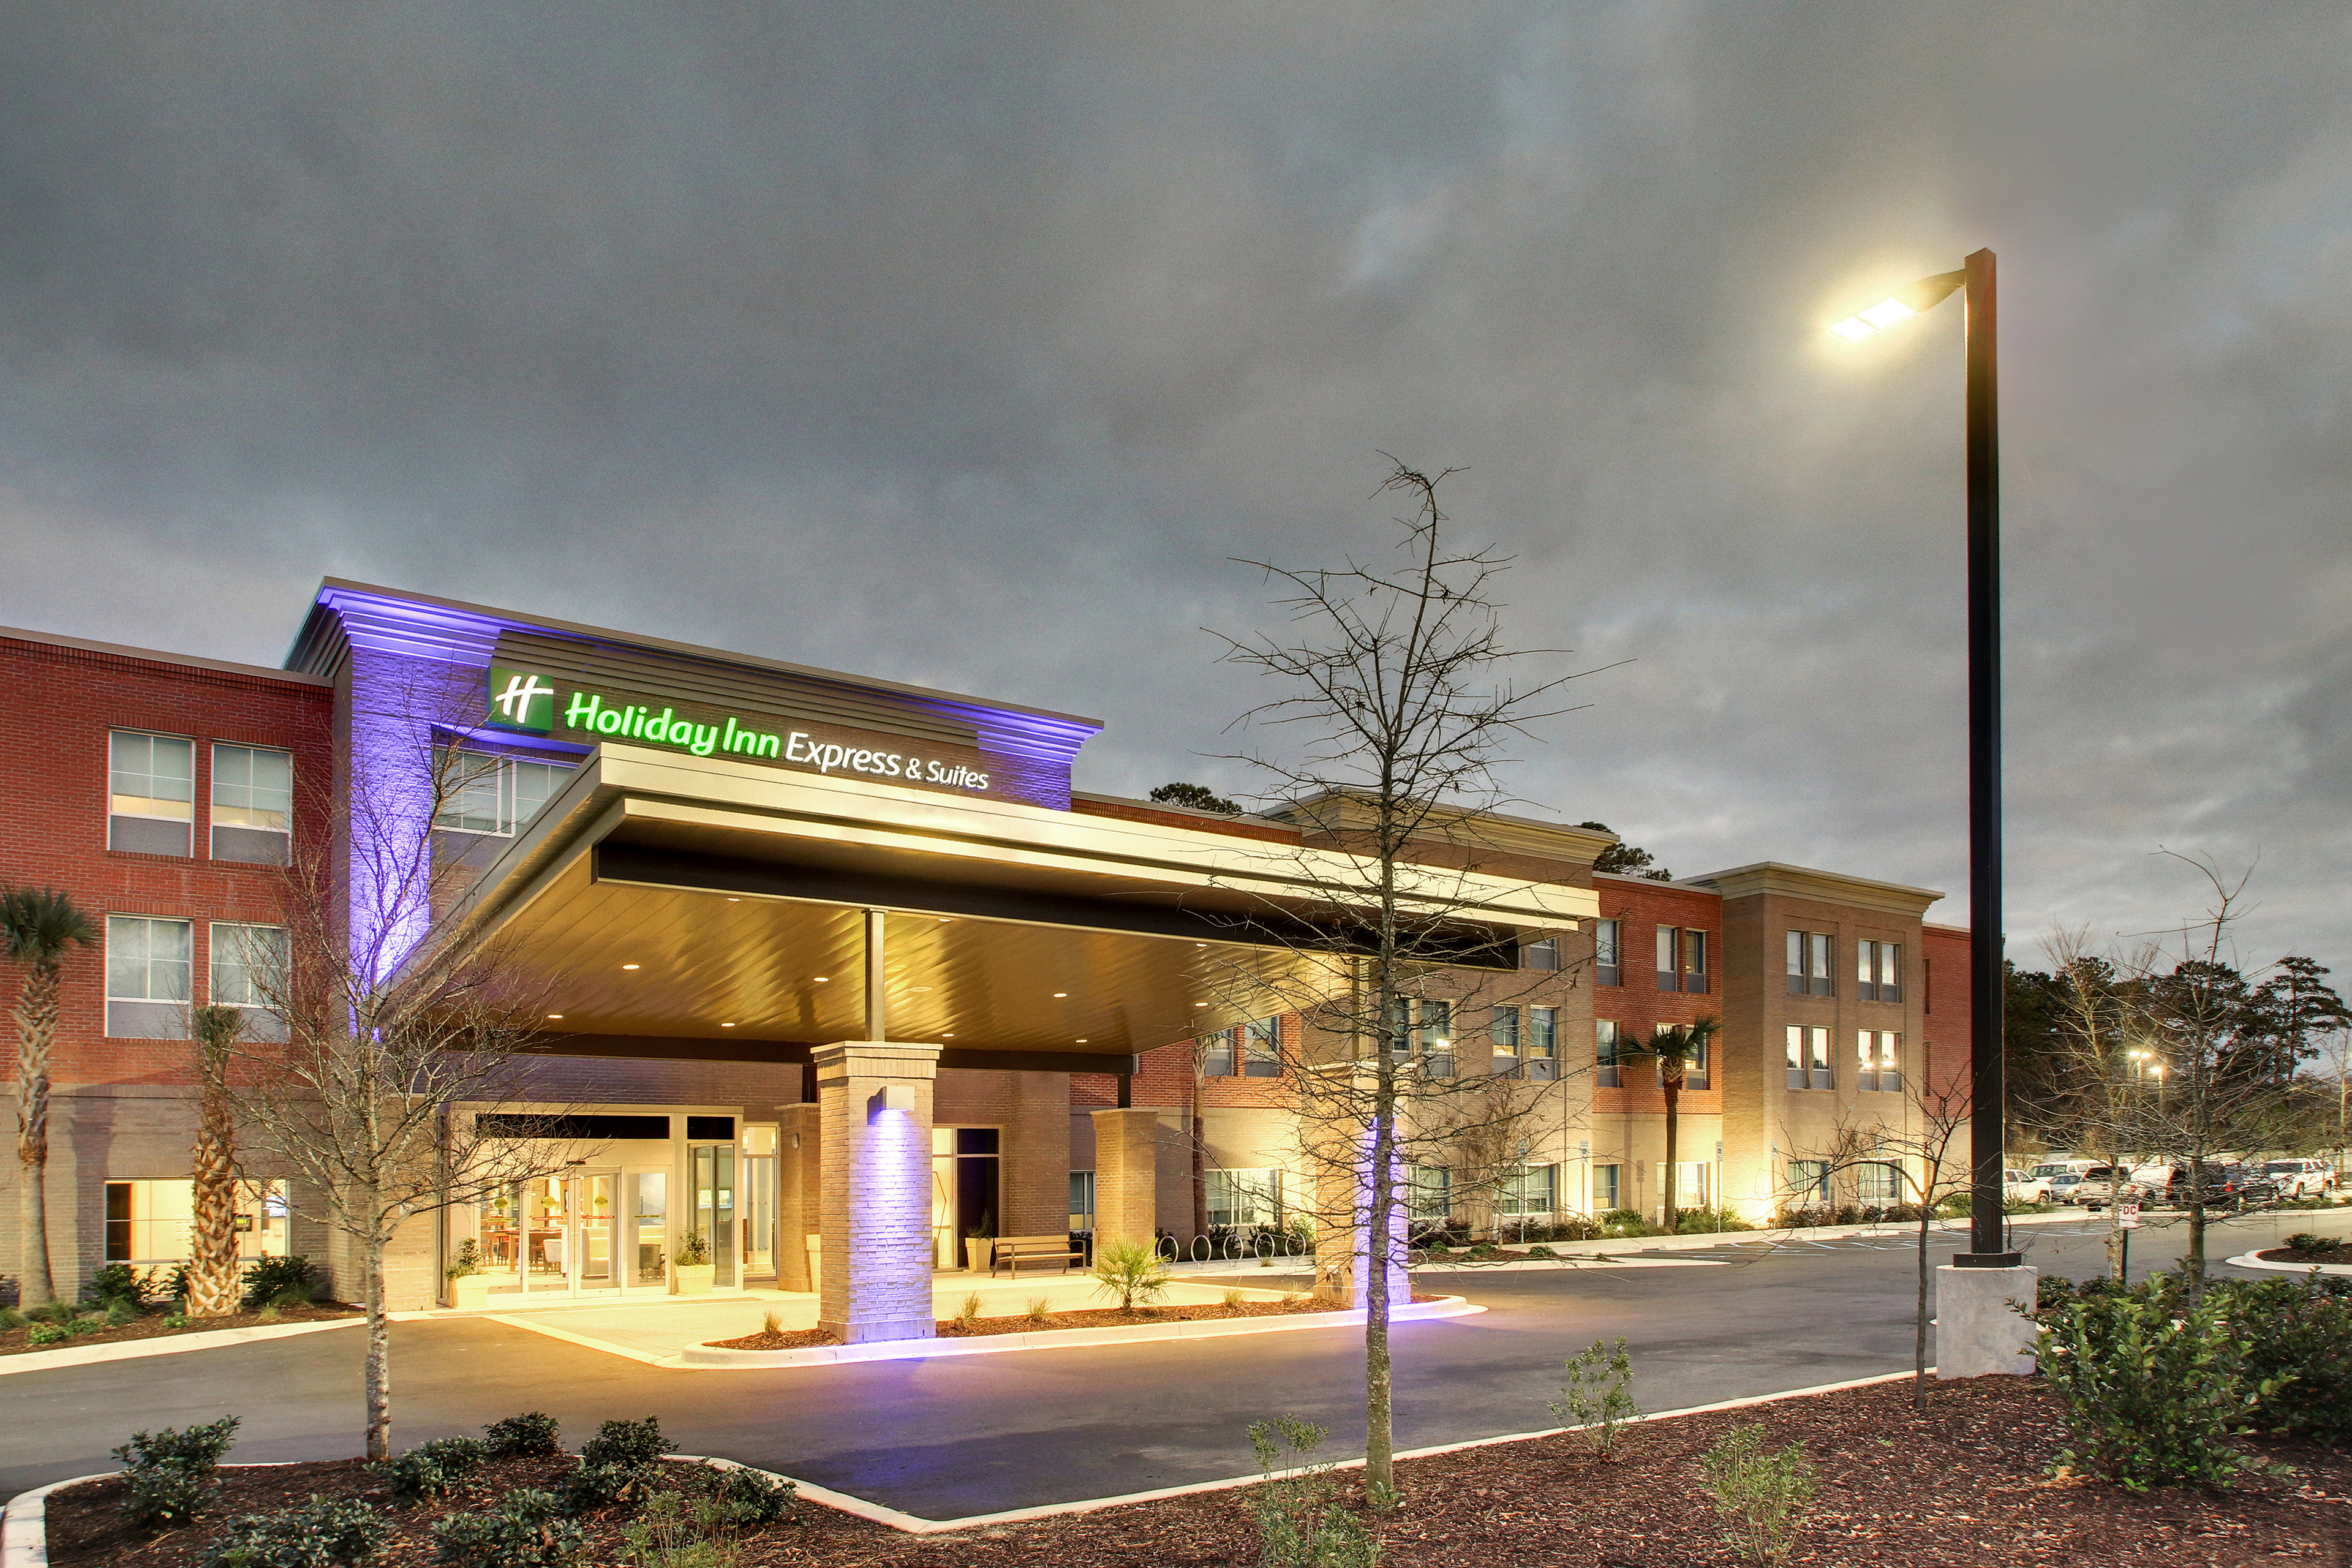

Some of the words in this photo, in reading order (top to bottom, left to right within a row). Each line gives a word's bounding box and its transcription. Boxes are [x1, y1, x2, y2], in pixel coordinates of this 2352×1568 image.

[564, 691, 720, 757] Holiday
[721, 715, 782, 759] Inn
[785, 731, 901, 774] Express
[905, 758, 921, 780] &
[925, 760, 990, 790] Suites
